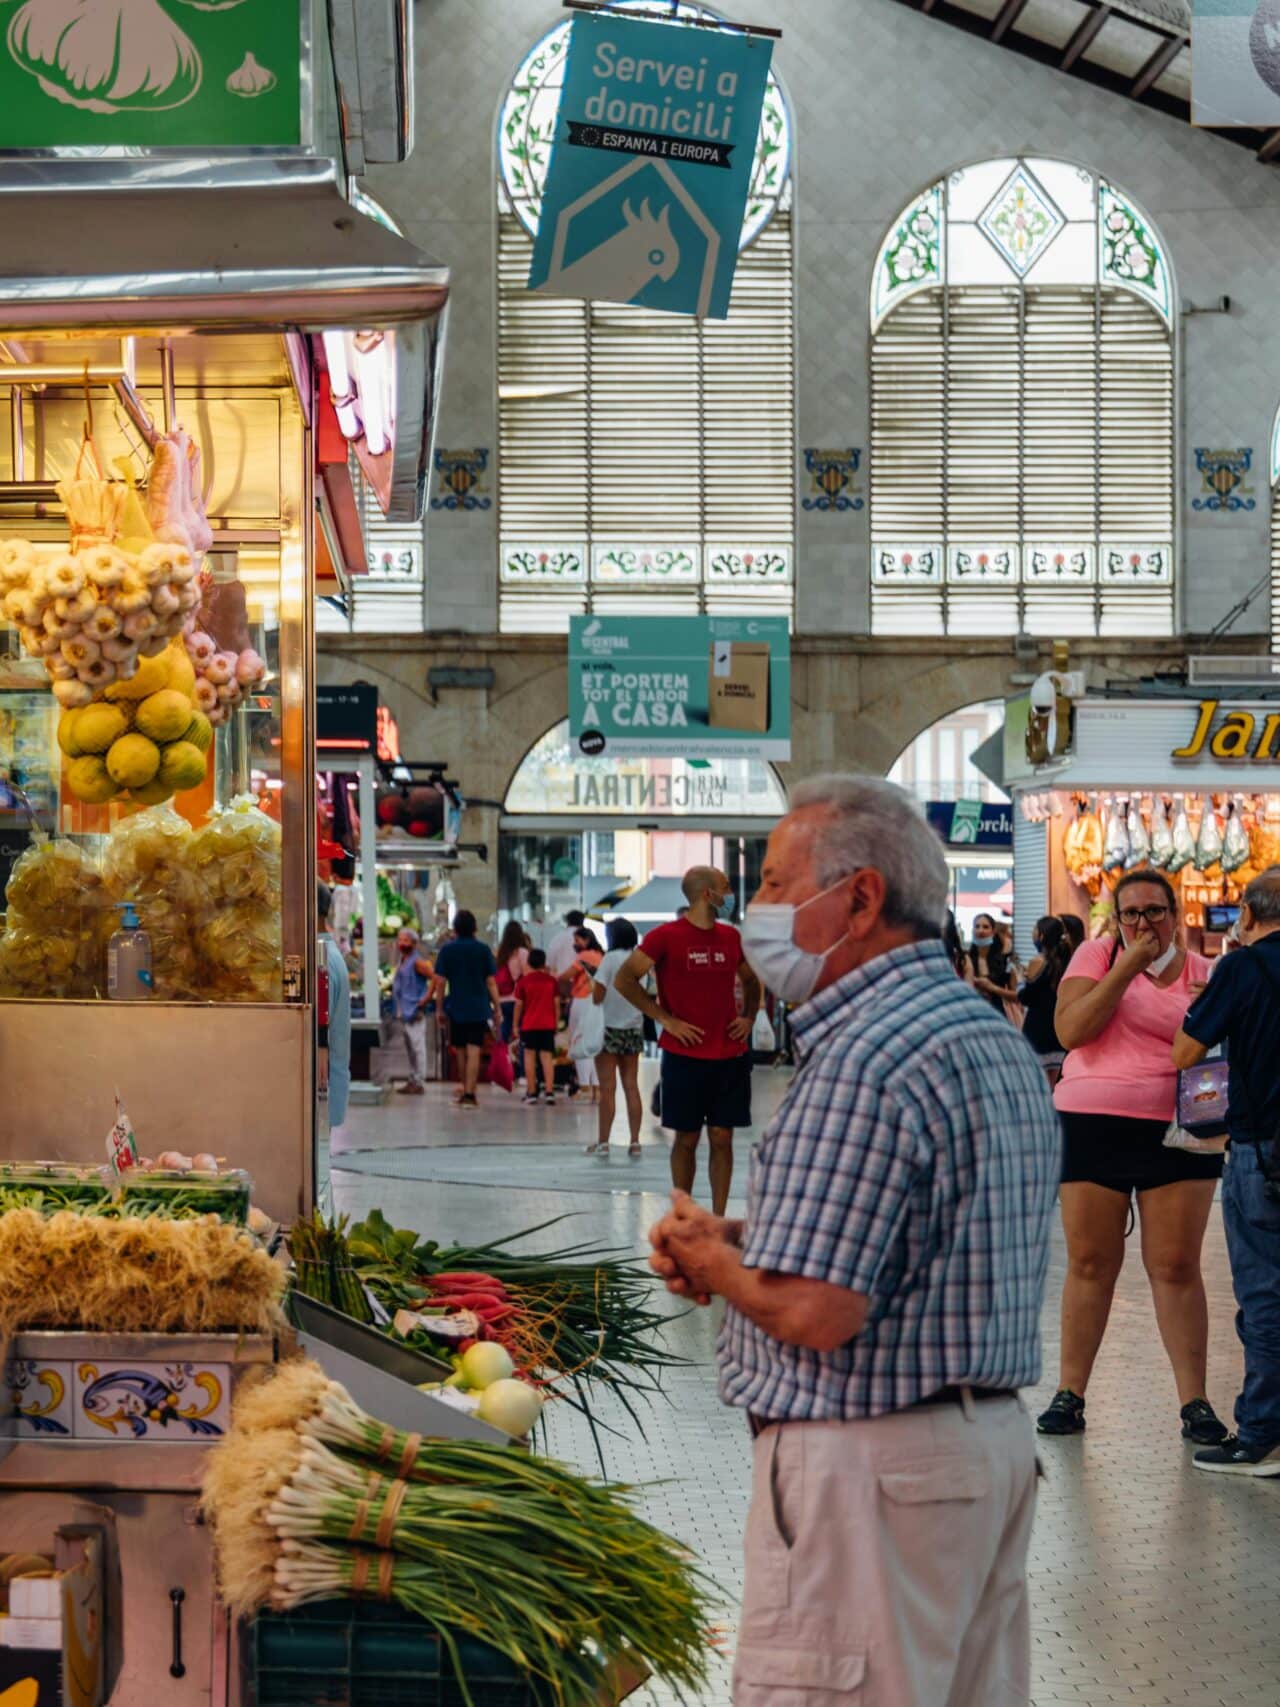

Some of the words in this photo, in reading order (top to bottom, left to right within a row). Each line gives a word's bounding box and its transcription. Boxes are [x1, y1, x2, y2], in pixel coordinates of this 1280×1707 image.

[592, 41, 708, 93] Servei
[716, 70, 738, 98] a
[584, 86, 734, 140] domicili
[602, 132, 658, 153] ESPANYA
[660, 141, 668, 154] I
[670, 144, 720, 163] EUROPA
[582, 674, 604, 688] ET
[611, 674, 688, 689] PORTEM
[582, 689, 611, 702] TOT
[616, 689, 632, 702] EL
[637, 689, 688, 702] SABOR
[582, 702, 600, 727] A
[612, 702, 688, 727] CASA
[976, 813, 1014, 833] orch
